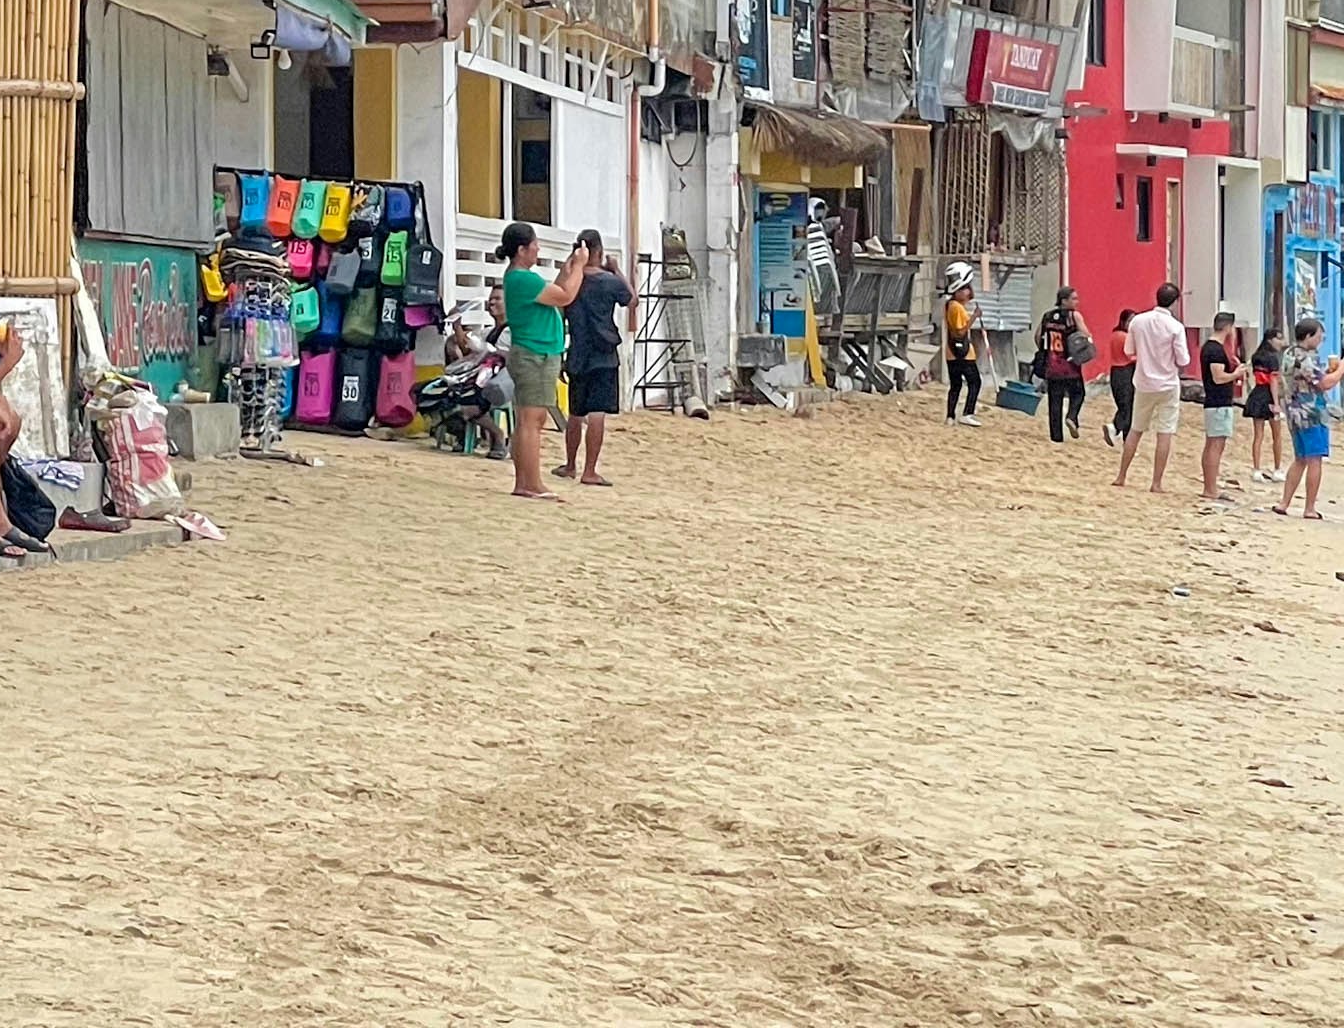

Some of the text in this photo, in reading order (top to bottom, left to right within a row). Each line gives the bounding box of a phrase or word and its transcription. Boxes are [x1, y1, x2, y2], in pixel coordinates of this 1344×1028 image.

[328, 204, 340, 214] 10
[387, 250, 401, 262] 15
[343, 385, 357, 399] 30
